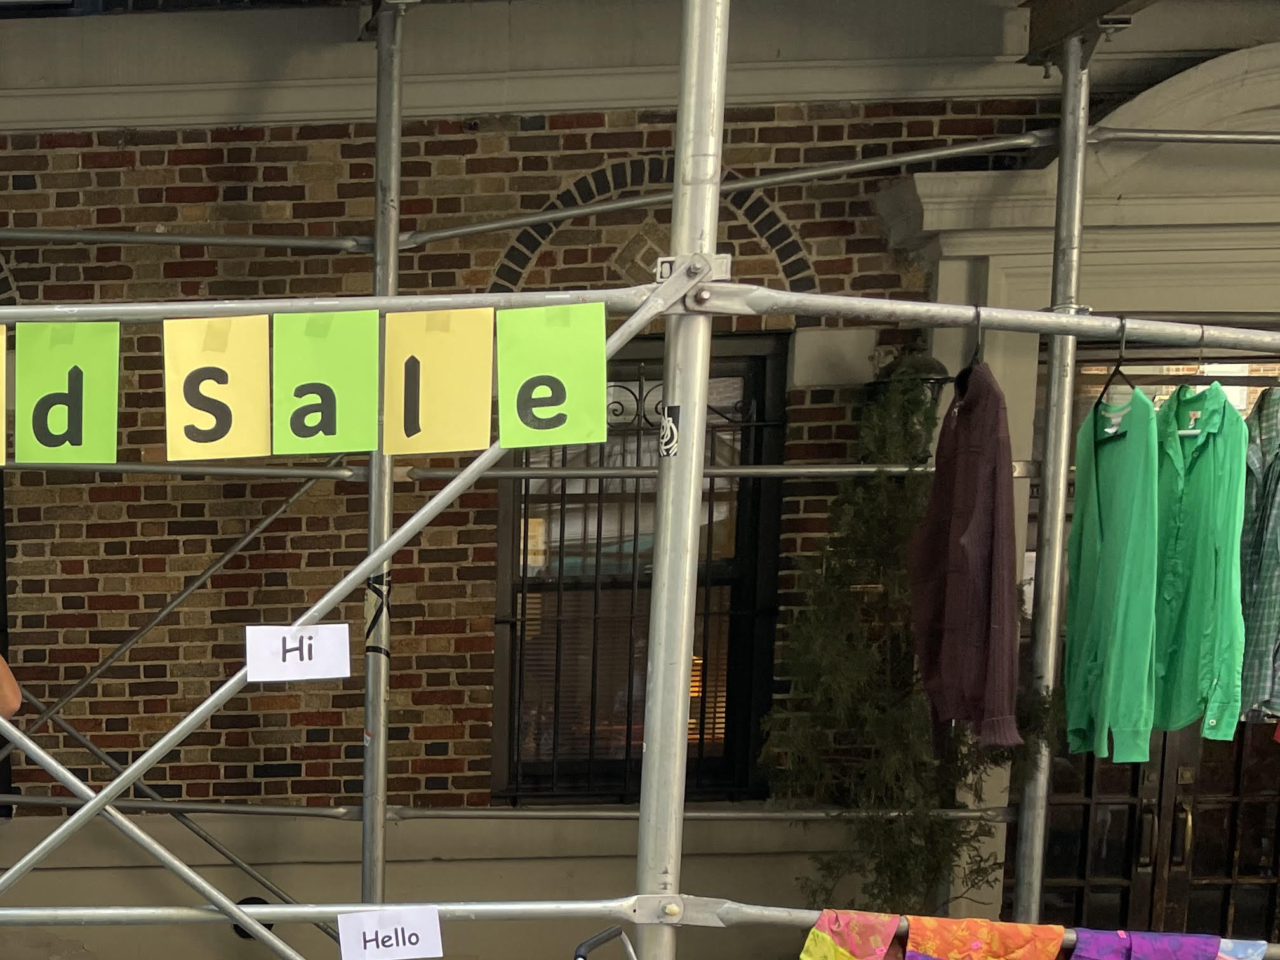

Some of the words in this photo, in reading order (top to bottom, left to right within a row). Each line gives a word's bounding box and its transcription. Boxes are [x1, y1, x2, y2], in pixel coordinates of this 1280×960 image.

[182, 353, 568, 444] Sale
[281, 635, 314, 663] Hi
[361, 928, 421, 952] Hello
